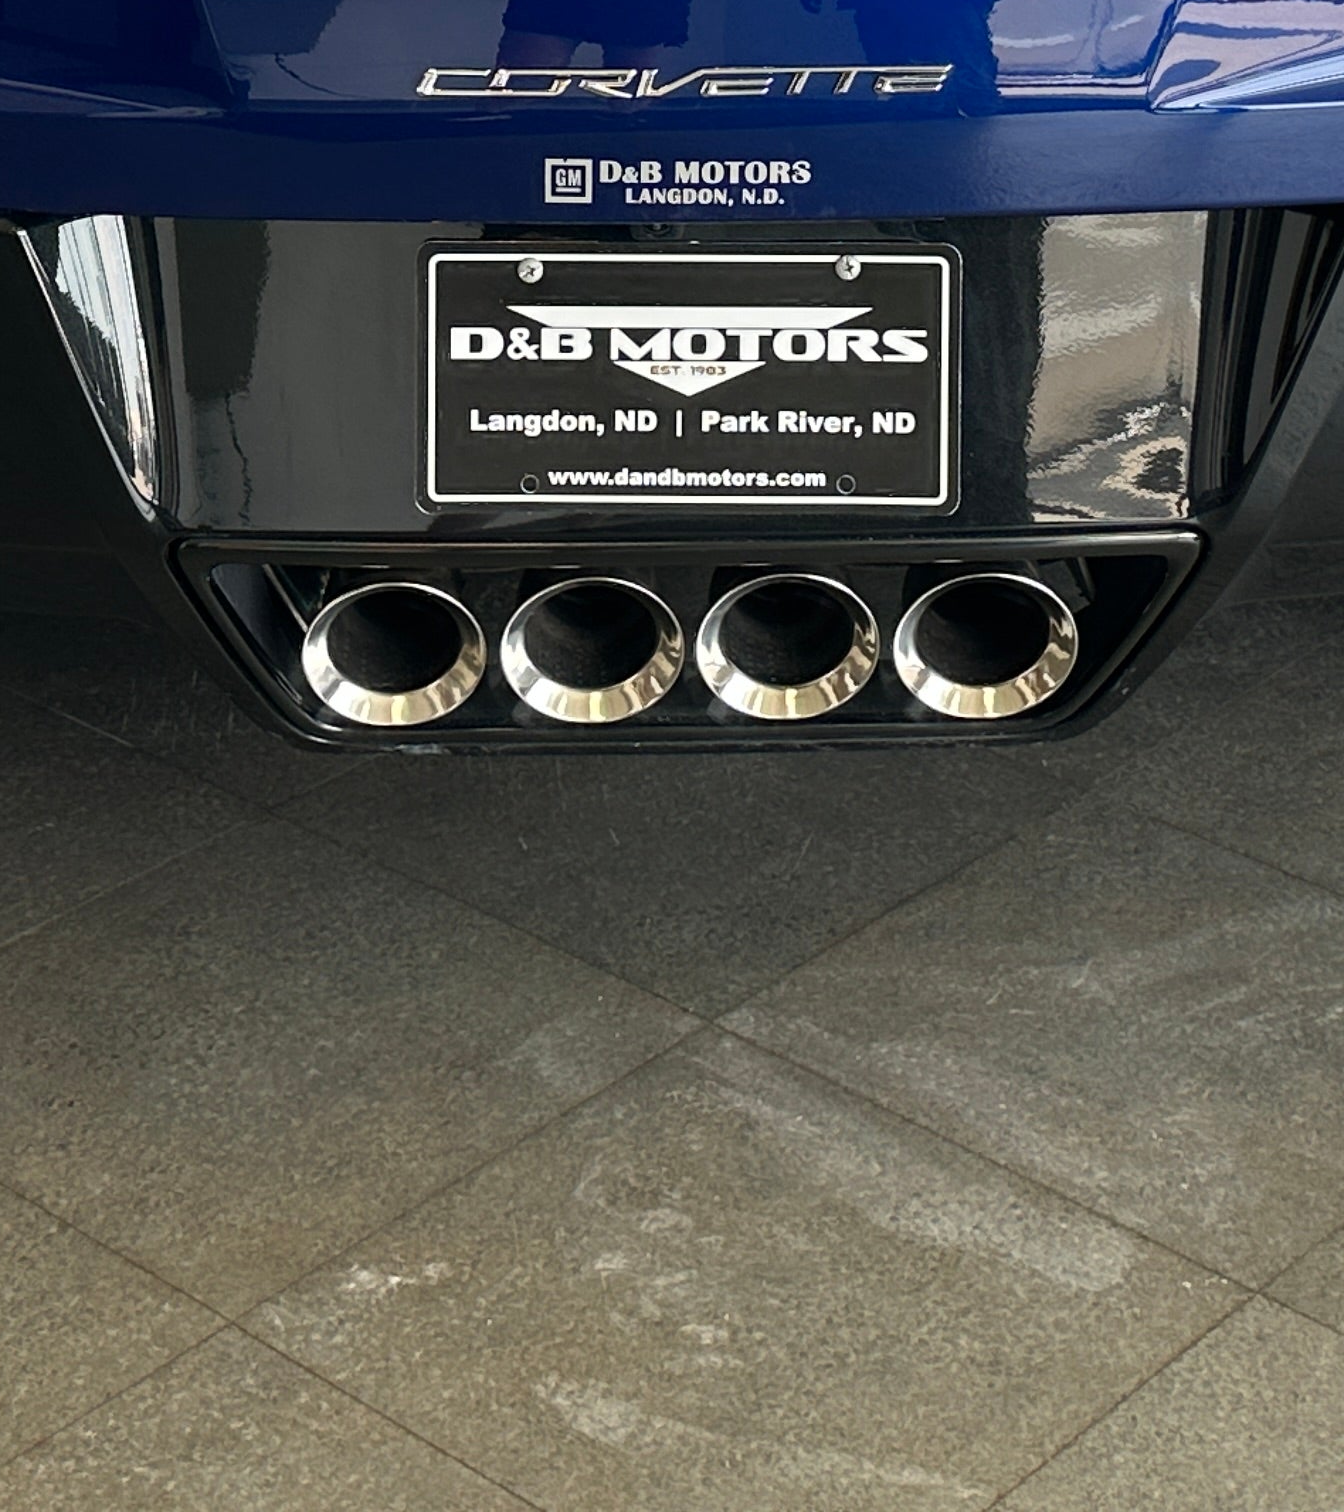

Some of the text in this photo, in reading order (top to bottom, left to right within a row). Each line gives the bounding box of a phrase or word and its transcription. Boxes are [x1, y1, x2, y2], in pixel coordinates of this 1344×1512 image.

[416, 63, 955, 100] CORVETTE
[555, 168, 582, 187] GM
[599, 160, 812, 185] D&B MOTORS
[625, 188, 785, 207] LANGDON, N.D.
[450, 326, 929, 362] D&B MOTORS
[470, 408, 605, 437] Langdon,
[614, 409, 658, 432] ND
[701, 410, 770, 433] Park
[777, 410, 863, 439] River,
[872, 411, 916, 434] ND
[547, 467, 827, 487] www.dandbmotors.com
